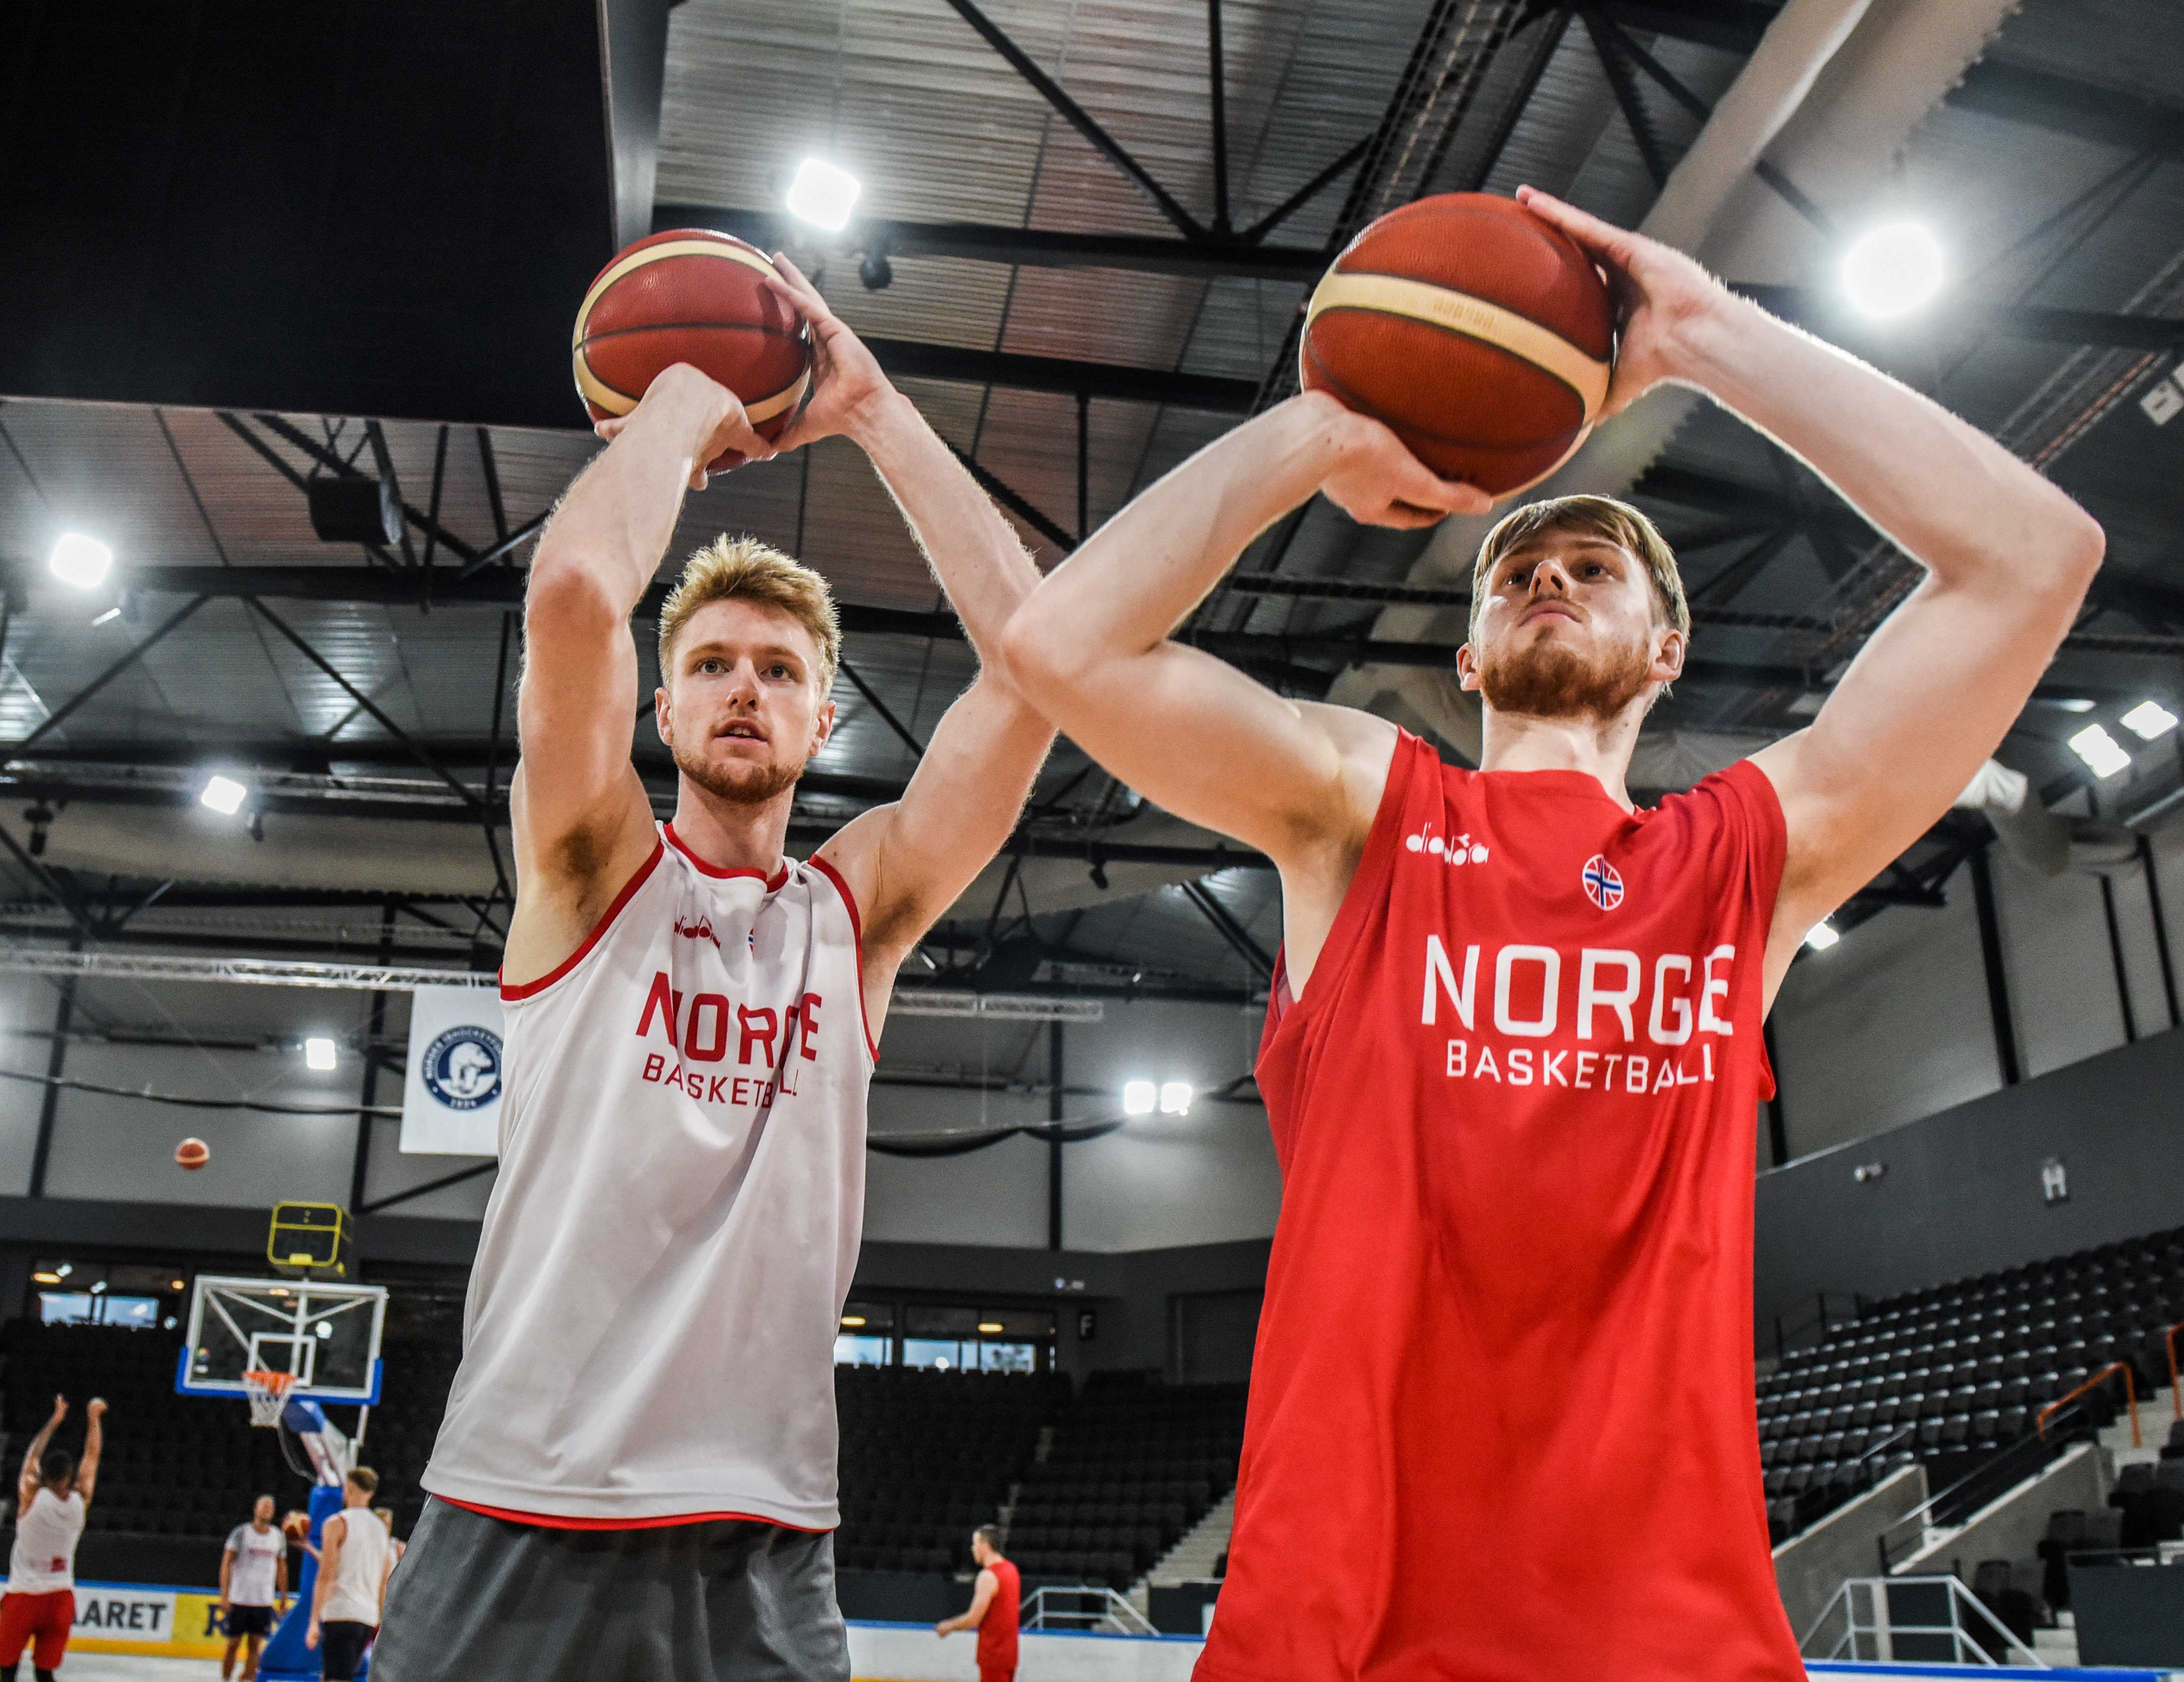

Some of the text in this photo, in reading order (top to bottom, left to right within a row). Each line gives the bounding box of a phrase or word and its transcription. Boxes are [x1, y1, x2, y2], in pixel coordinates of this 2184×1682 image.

[1421, 934, 1736, 1046] NORGE
[642, 1053, 799, 1109] BASKETBL
[1446, 1039, 1715, 1095] BASKETBALL
[74, 1600, 168, 1631] ARET
